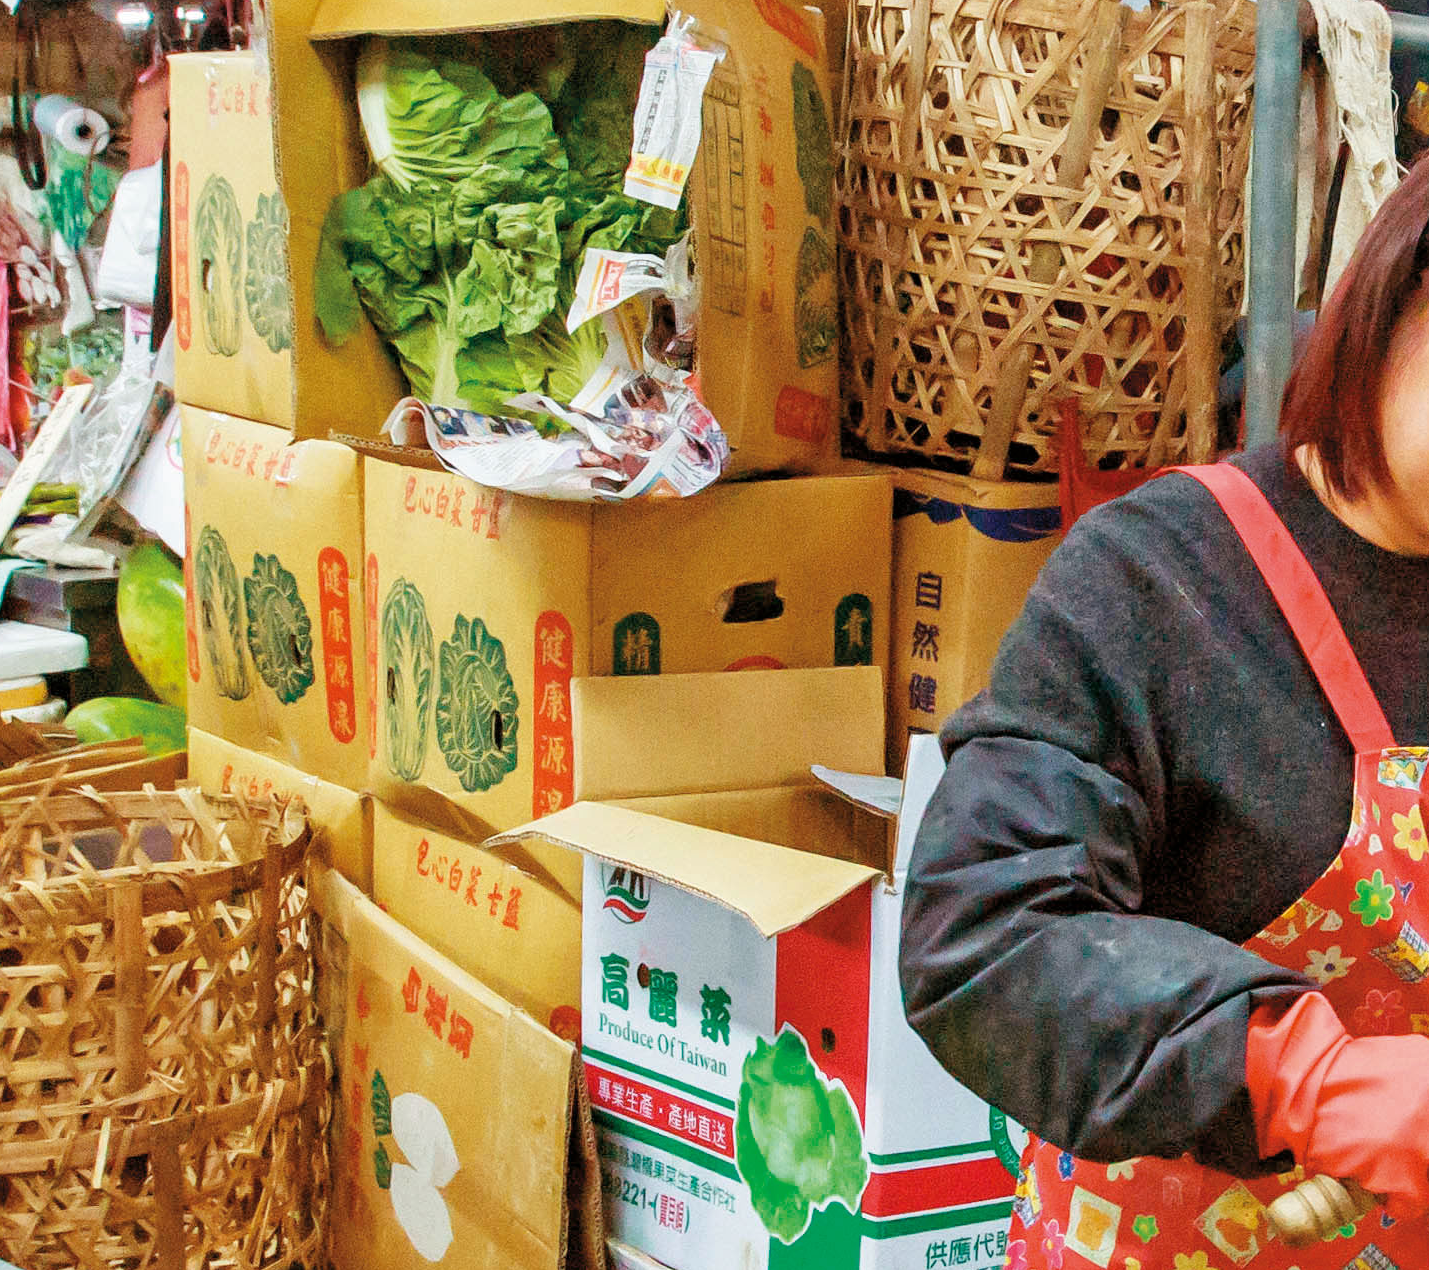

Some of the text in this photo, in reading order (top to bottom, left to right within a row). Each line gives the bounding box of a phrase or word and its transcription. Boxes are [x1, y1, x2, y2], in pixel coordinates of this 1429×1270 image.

[907, 572, 943, 733] 自然健
[416, 838, 483, 908] 包心白菜
[600, 953, 732, 1047] 高麗菜
[599, 1012, 728, 1077] Produce Of Taiwan
